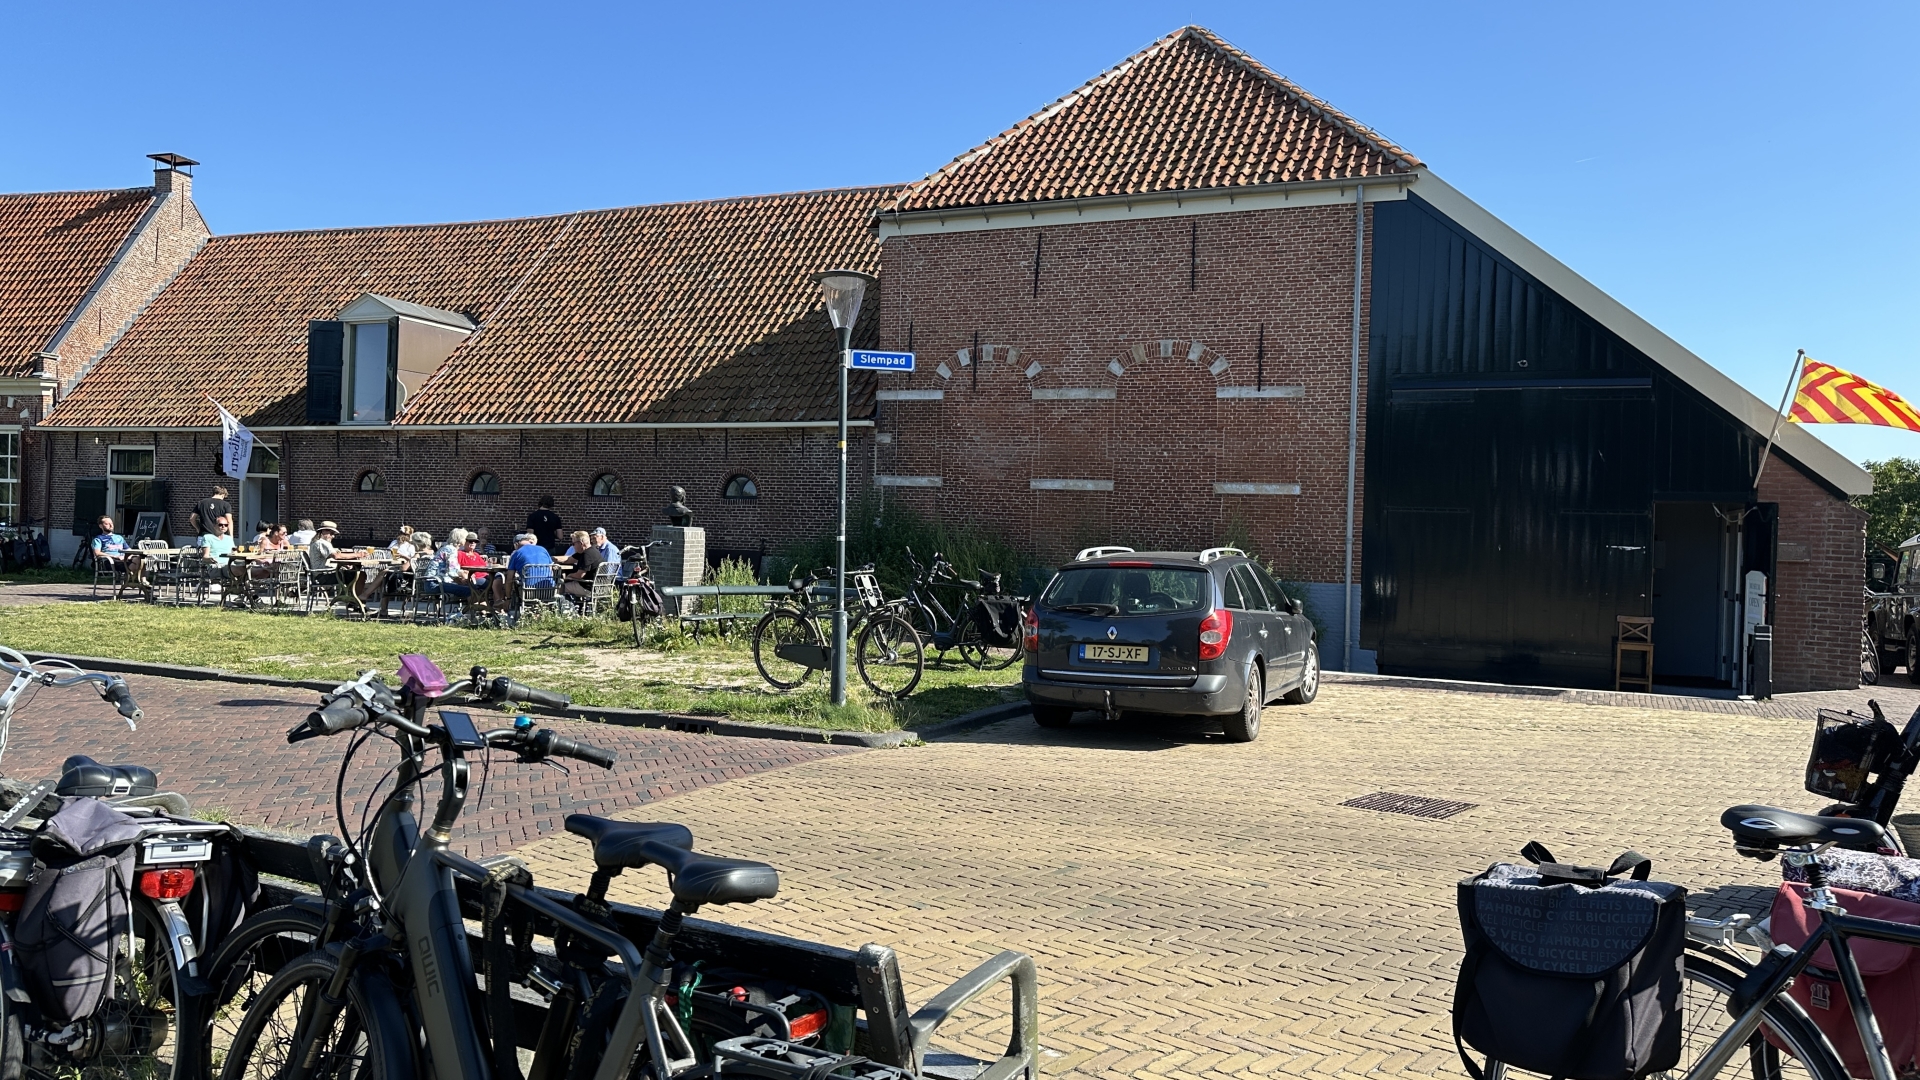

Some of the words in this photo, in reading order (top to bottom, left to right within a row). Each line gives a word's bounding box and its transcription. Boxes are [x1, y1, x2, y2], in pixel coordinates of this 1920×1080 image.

[860, 354, 906, 366] Slempad
[1092, 646, 1142, 659] 17-SJ-XF
[1504, 891, 1545, 907] SYKKEL
[1589, 900, 1622, 911] FIETS
[1478, 901, 1542, 918] FAHRRAD
[1586, 911, 1654, 924] BICICLETTA
[1562, 923, 1603, 936] SYKKEL
[1501, 928, 1537, 943] VELO
[1540, 935, 1600, 949] FAHRRAD
[1603, 939, 1640, 950] CYKE
[1538, 946, 1588, 960] BICYCLE
[1590, 951, 1617, 962] FIETS
[418, 935, 441, 998] QWIC
[1543, 961, 1582, 974] CYKEL
